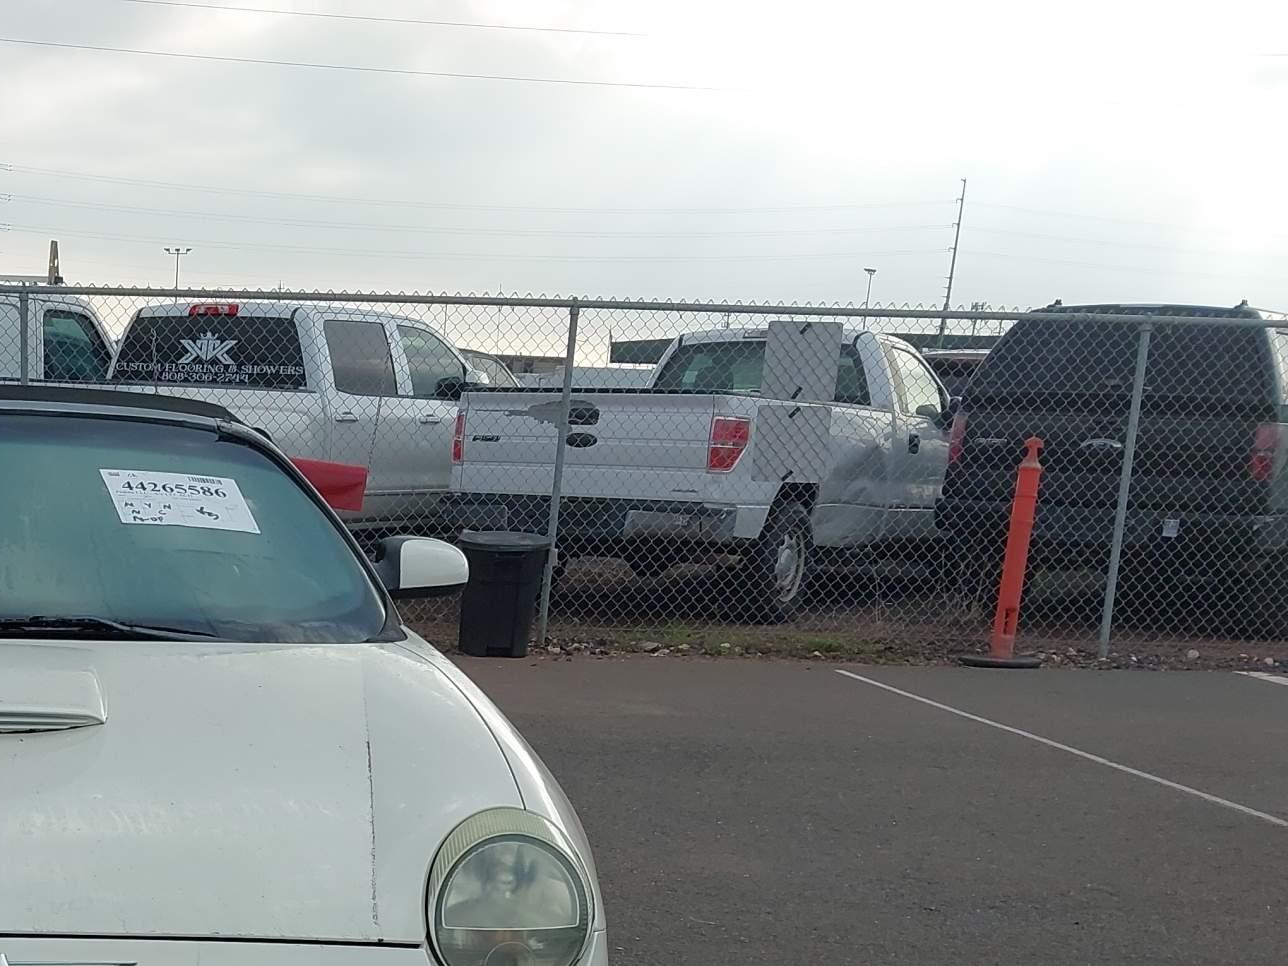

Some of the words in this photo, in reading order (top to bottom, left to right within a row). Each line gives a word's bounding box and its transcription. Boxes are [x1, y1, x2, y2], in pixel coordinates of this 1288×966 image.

[165, 363, 224, 373] FLOORING
[240, 364, 304, 375] SHOWERS
[121, 480, 227, 499] 44265586
